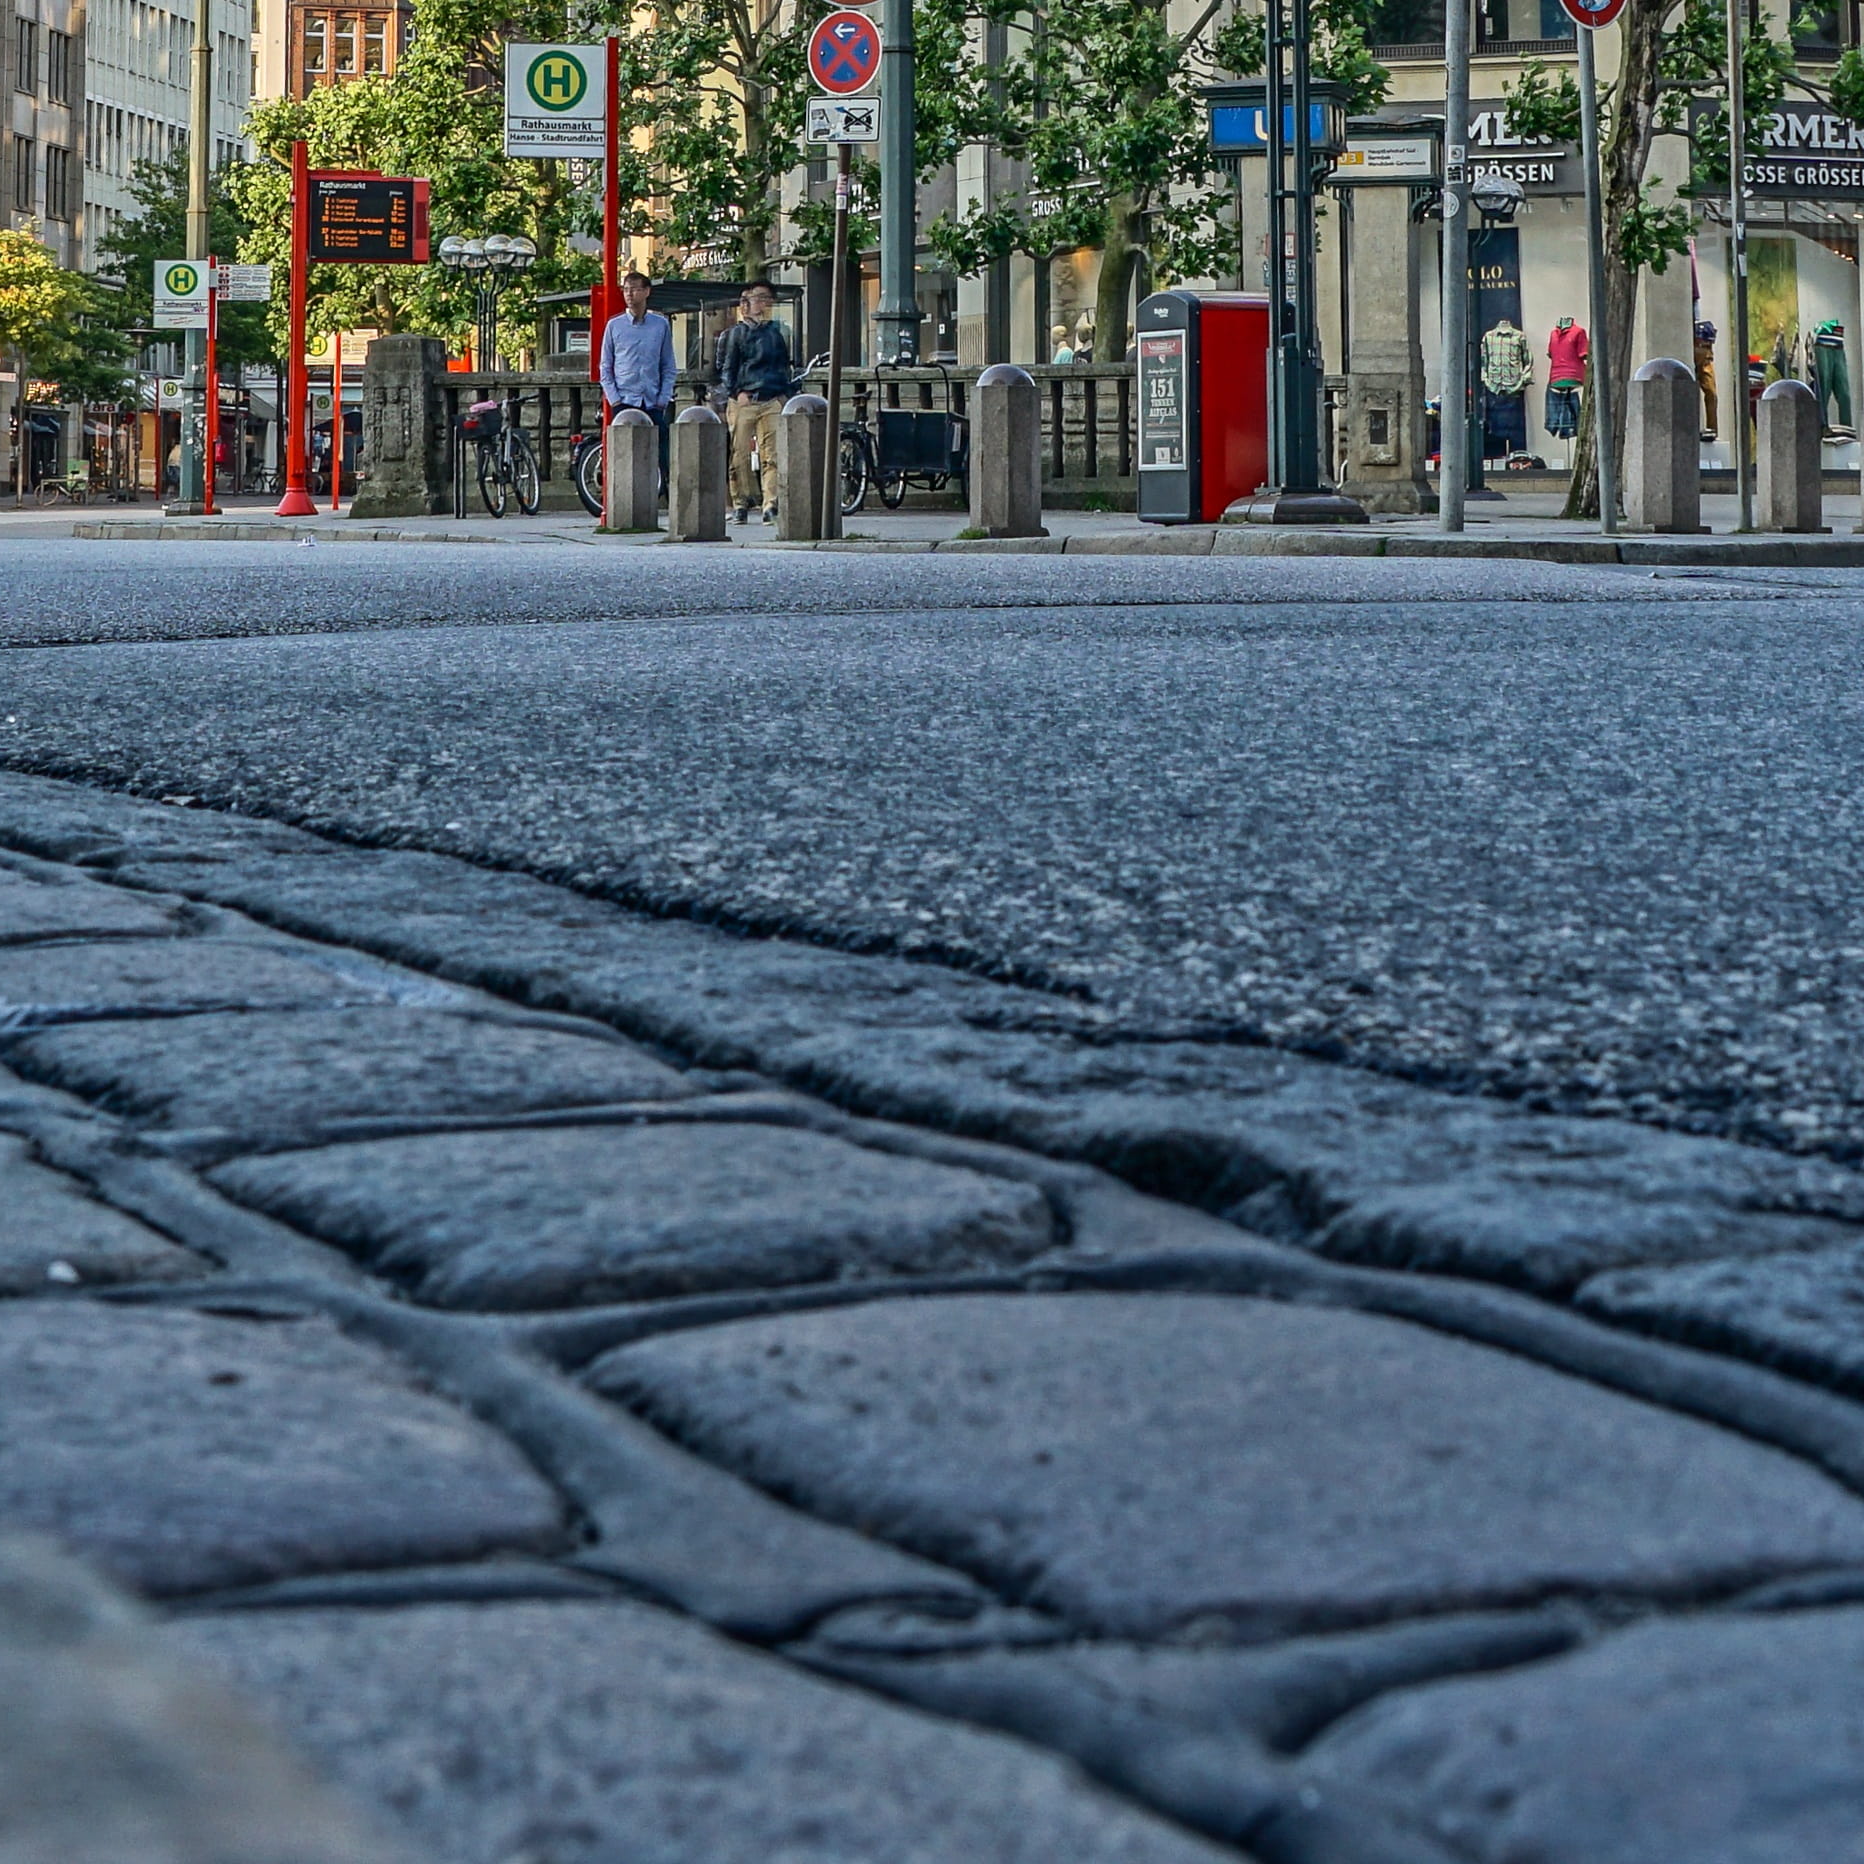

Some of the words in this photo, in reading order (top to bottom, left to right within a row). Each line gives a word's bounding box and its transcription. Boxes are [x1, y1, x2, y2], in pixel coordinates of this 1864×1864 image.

[543, 64, 570, 97] H
[521, 120, 592, 131] Rathausmarkt
[510, 133, 535, 141] Hanse
[541, 133, 603, 143] Stadtrundfahrt
[319, 181, 366, 190] Rathausmarkt
[1032, 197, 1064, 217] GROSS
[174, 271, 189, 289] H
[1150, 378, 1176, 398] 151
[92, 403, 116, 412] ara
